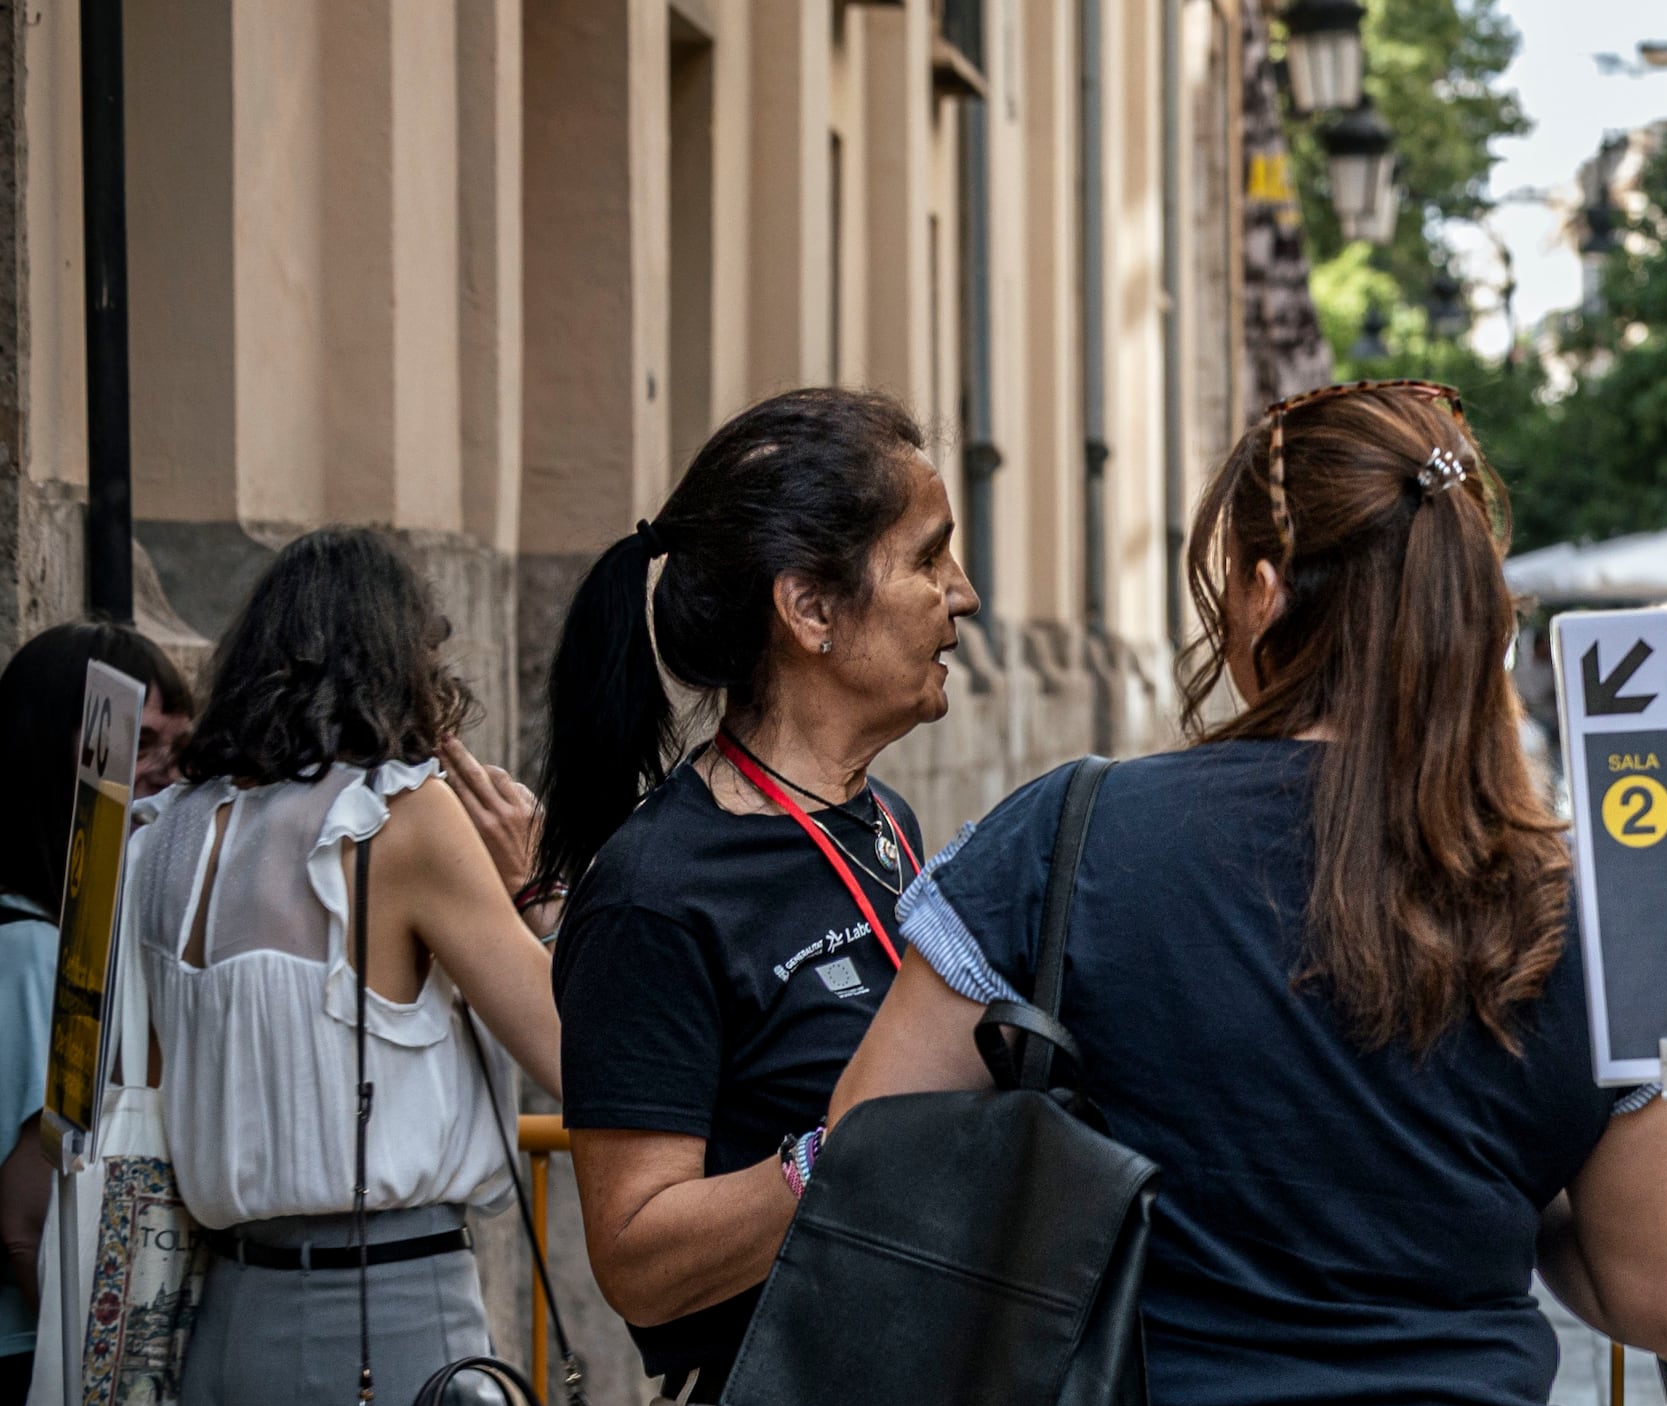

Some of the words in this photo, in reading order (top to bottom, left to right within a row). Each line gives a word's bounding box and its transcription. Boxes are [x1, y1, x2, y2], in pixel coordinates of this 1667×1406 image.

[96, 696, 112, 778] C
[1608, 754, 1659, 771] SALA
[1621, 785, 1656, 835] 2
